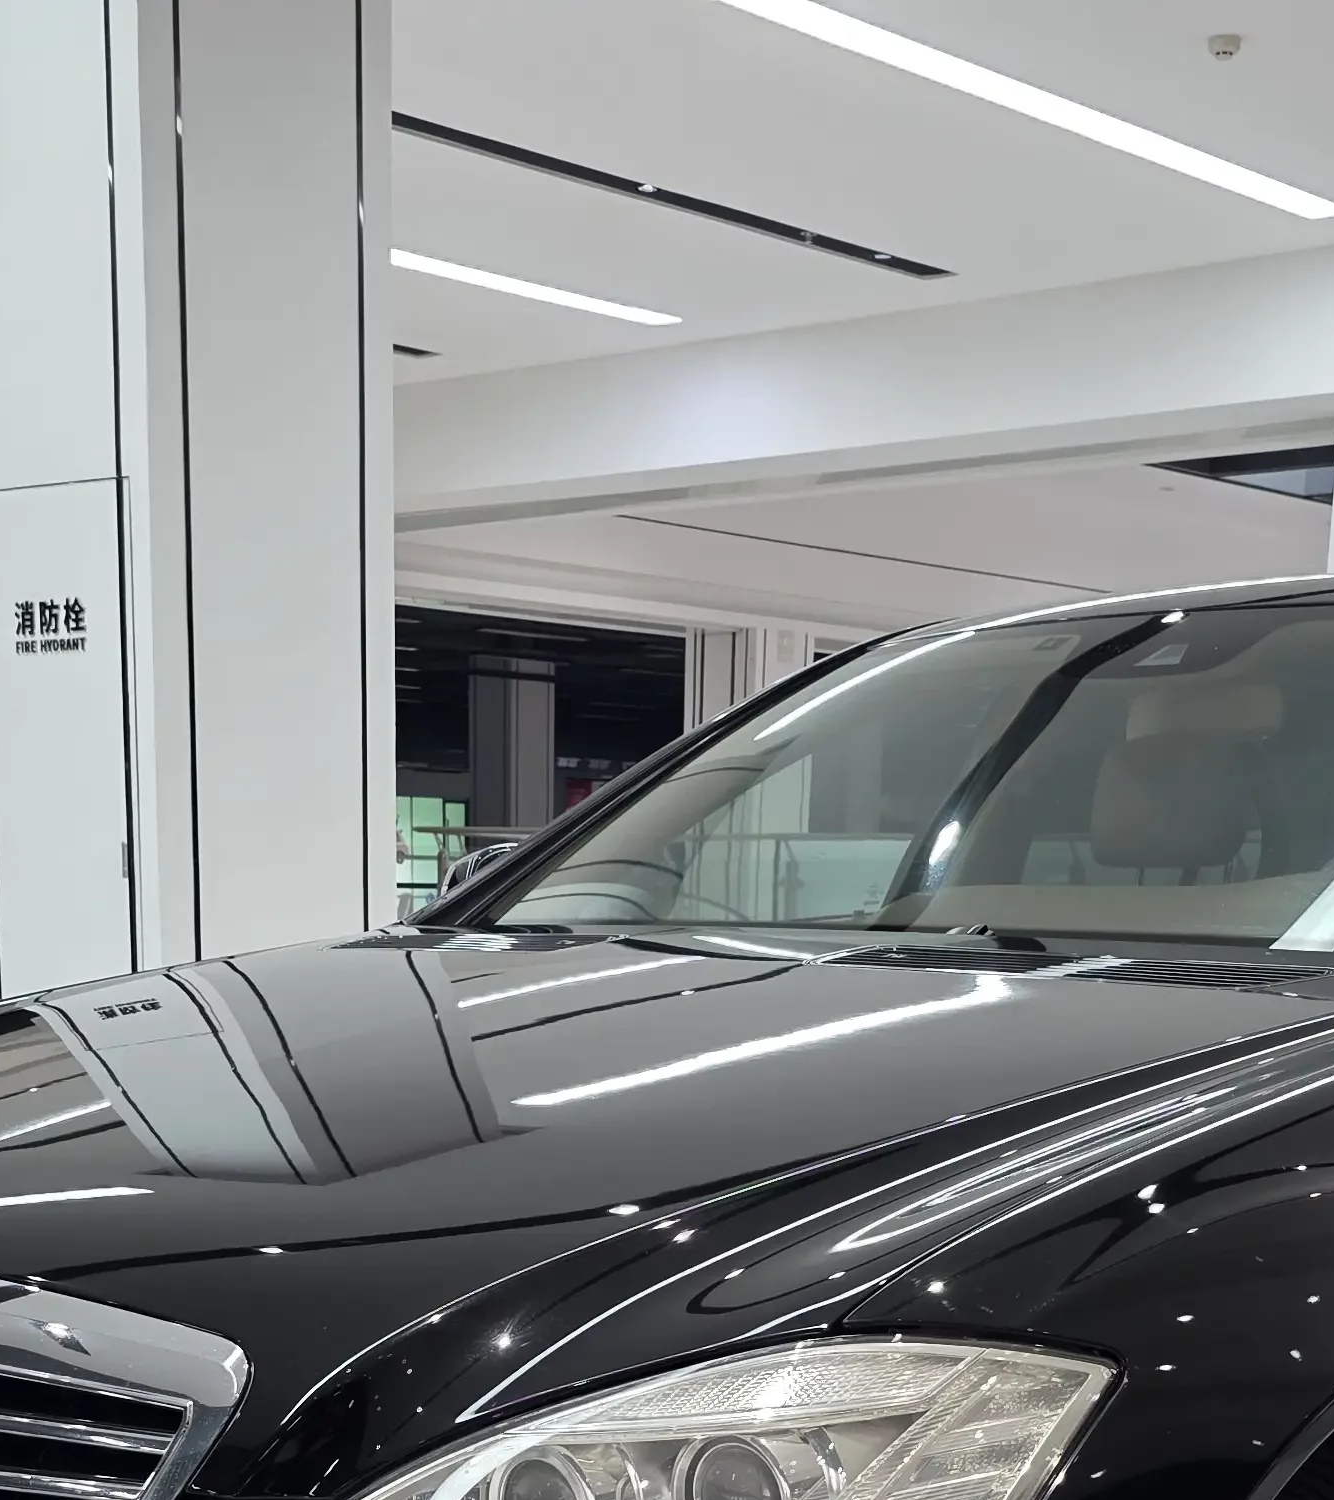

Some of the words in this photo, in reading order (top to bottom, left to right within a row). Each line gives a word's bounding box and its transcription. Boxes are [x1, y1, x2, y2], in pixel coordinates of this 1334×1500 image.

[14, 597, 87, 635] 消防栓
[15, 640, 37, 654] FIRE
[40, 638, 87, 652] HYDRANT
